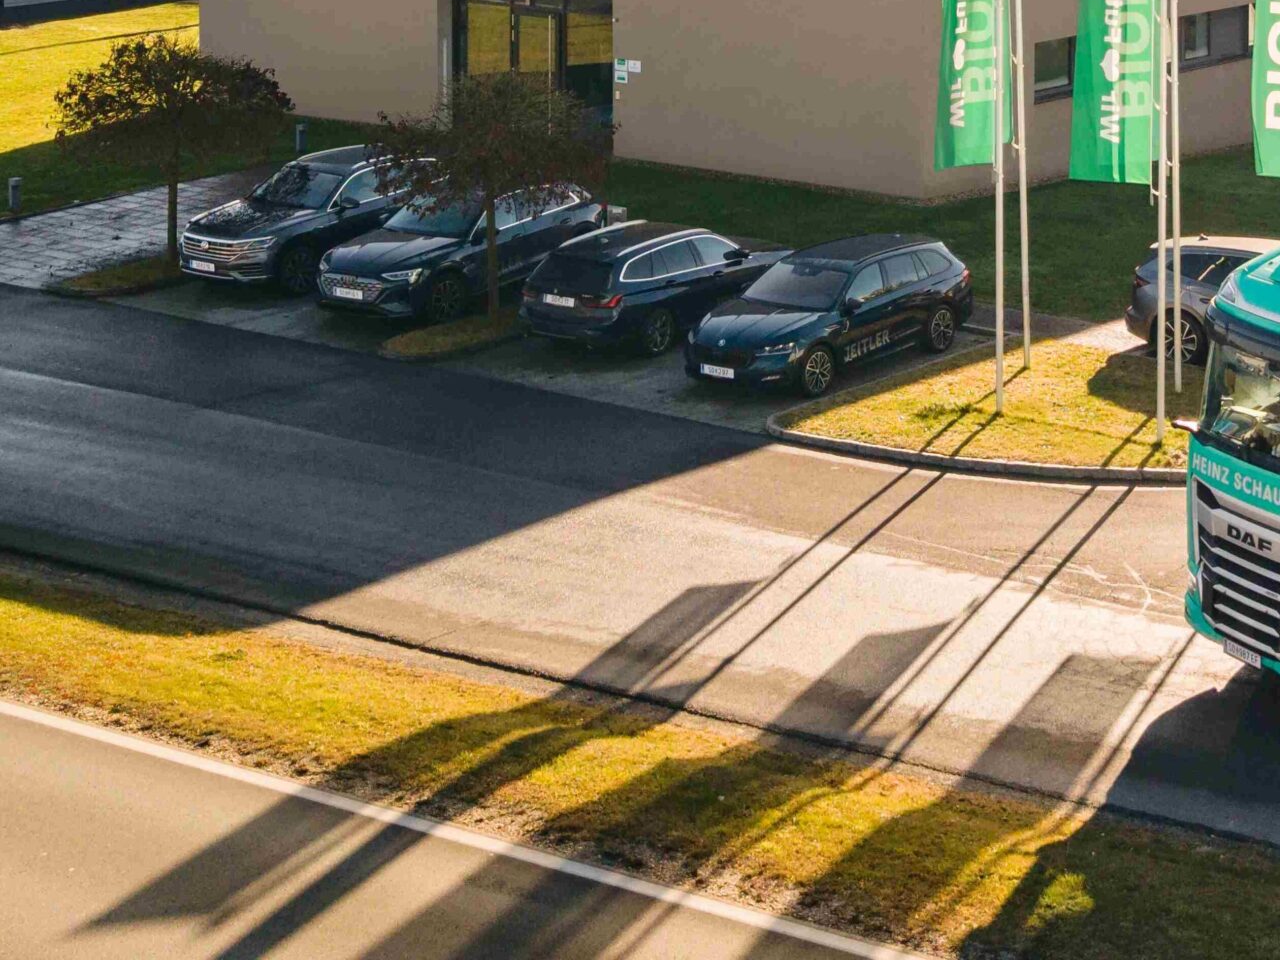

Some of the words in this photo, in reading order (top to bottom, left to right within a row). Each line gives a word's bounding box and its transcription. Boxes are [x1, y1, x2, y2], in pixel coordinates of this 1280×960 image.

[844, 329, 891, 363] JEITLER
[1192, 453, 1229, 485] HEINZ
[1227, 524, 1272, 552] DAF
